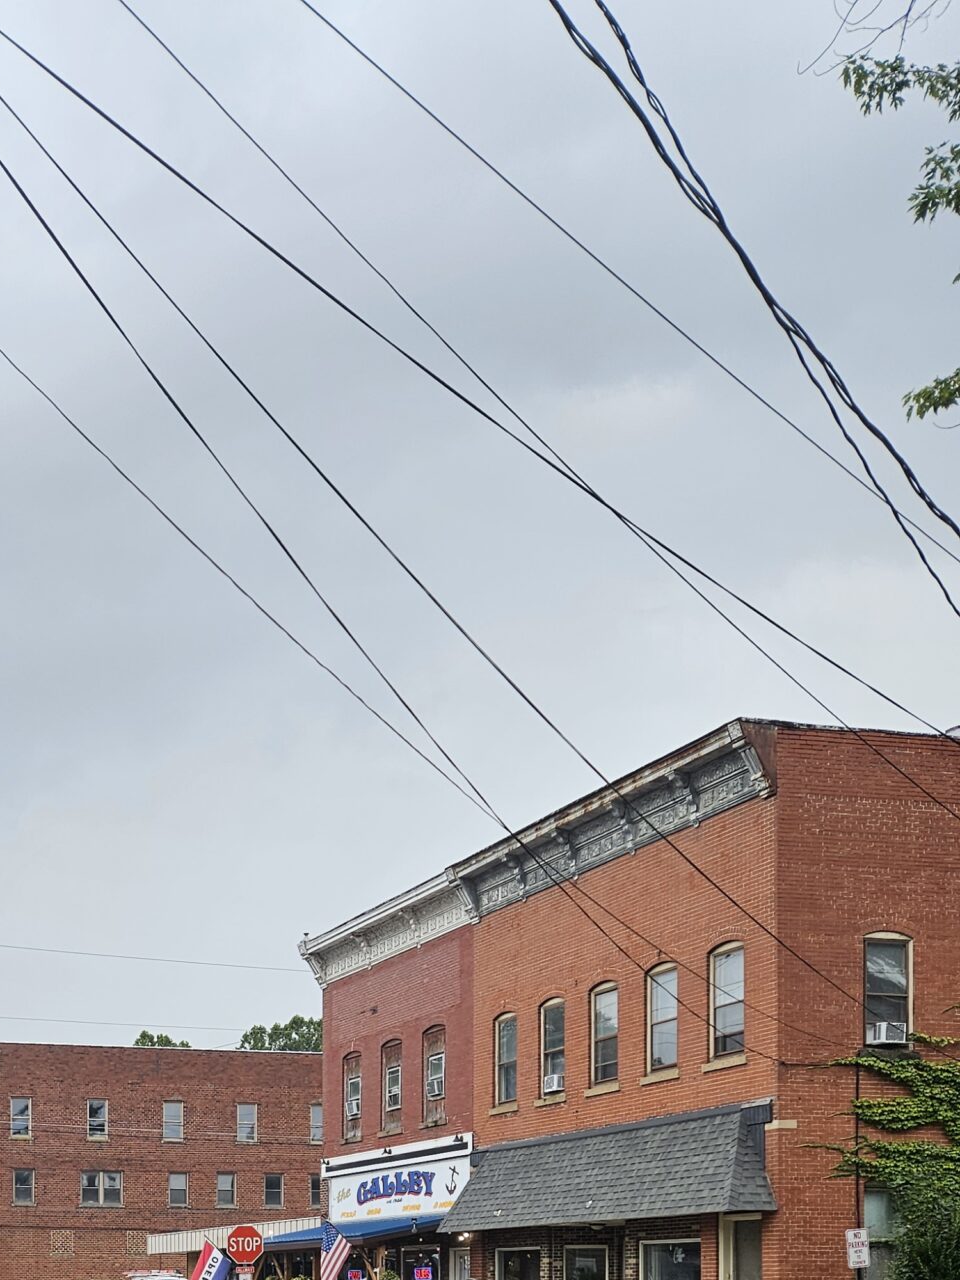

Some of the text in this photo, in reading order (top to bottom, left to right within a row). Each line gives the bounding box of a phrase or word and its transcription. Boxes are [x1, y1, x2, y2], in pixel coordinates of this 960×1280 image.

[336, 1187, 351, 1204] the
[356, 1170, 436, 1206] GALLEY
[229, 1237, 261, 1252] STOP
